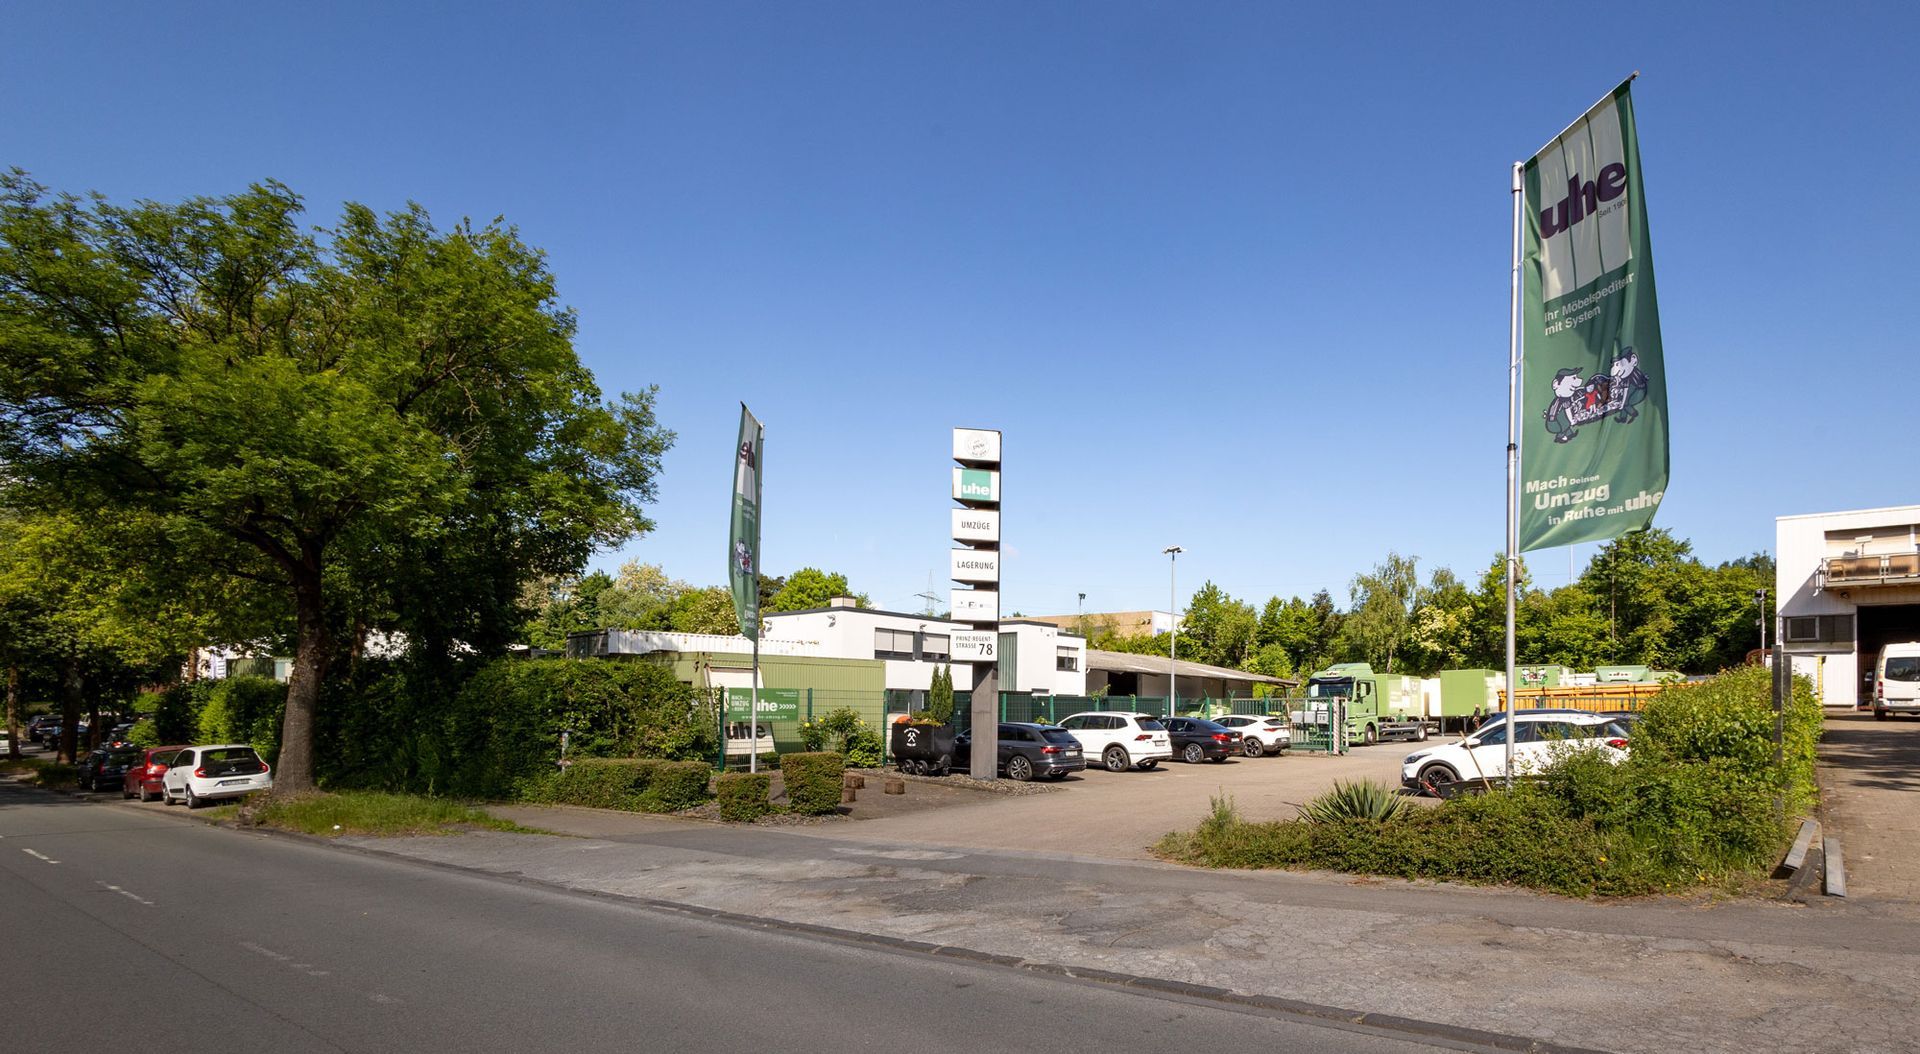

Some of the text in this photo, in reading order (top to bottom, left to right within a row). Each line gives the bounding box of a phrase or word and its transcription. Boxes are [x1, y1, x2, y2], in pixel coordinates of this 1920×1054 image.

[1540, 162, 1627, 239] uhe
[1544, 309, 1560, 323] Ihr
[1544, 305, 1601, 336] mit System
[962, 482, 990, 496] uhe
[1526, 474, 1600, 494] Mach Deinen
[1535, 484, 1610, 510] Umzug
[1548, 491, 1664, 526] in Ruhe mit uhe
[961, 520, 990, 530] UMZÜGE
[957, 560, 994, 570] LAGERUNG
[979, 643, 993, 656] 78
[725, 721, 766, 739] uhe
